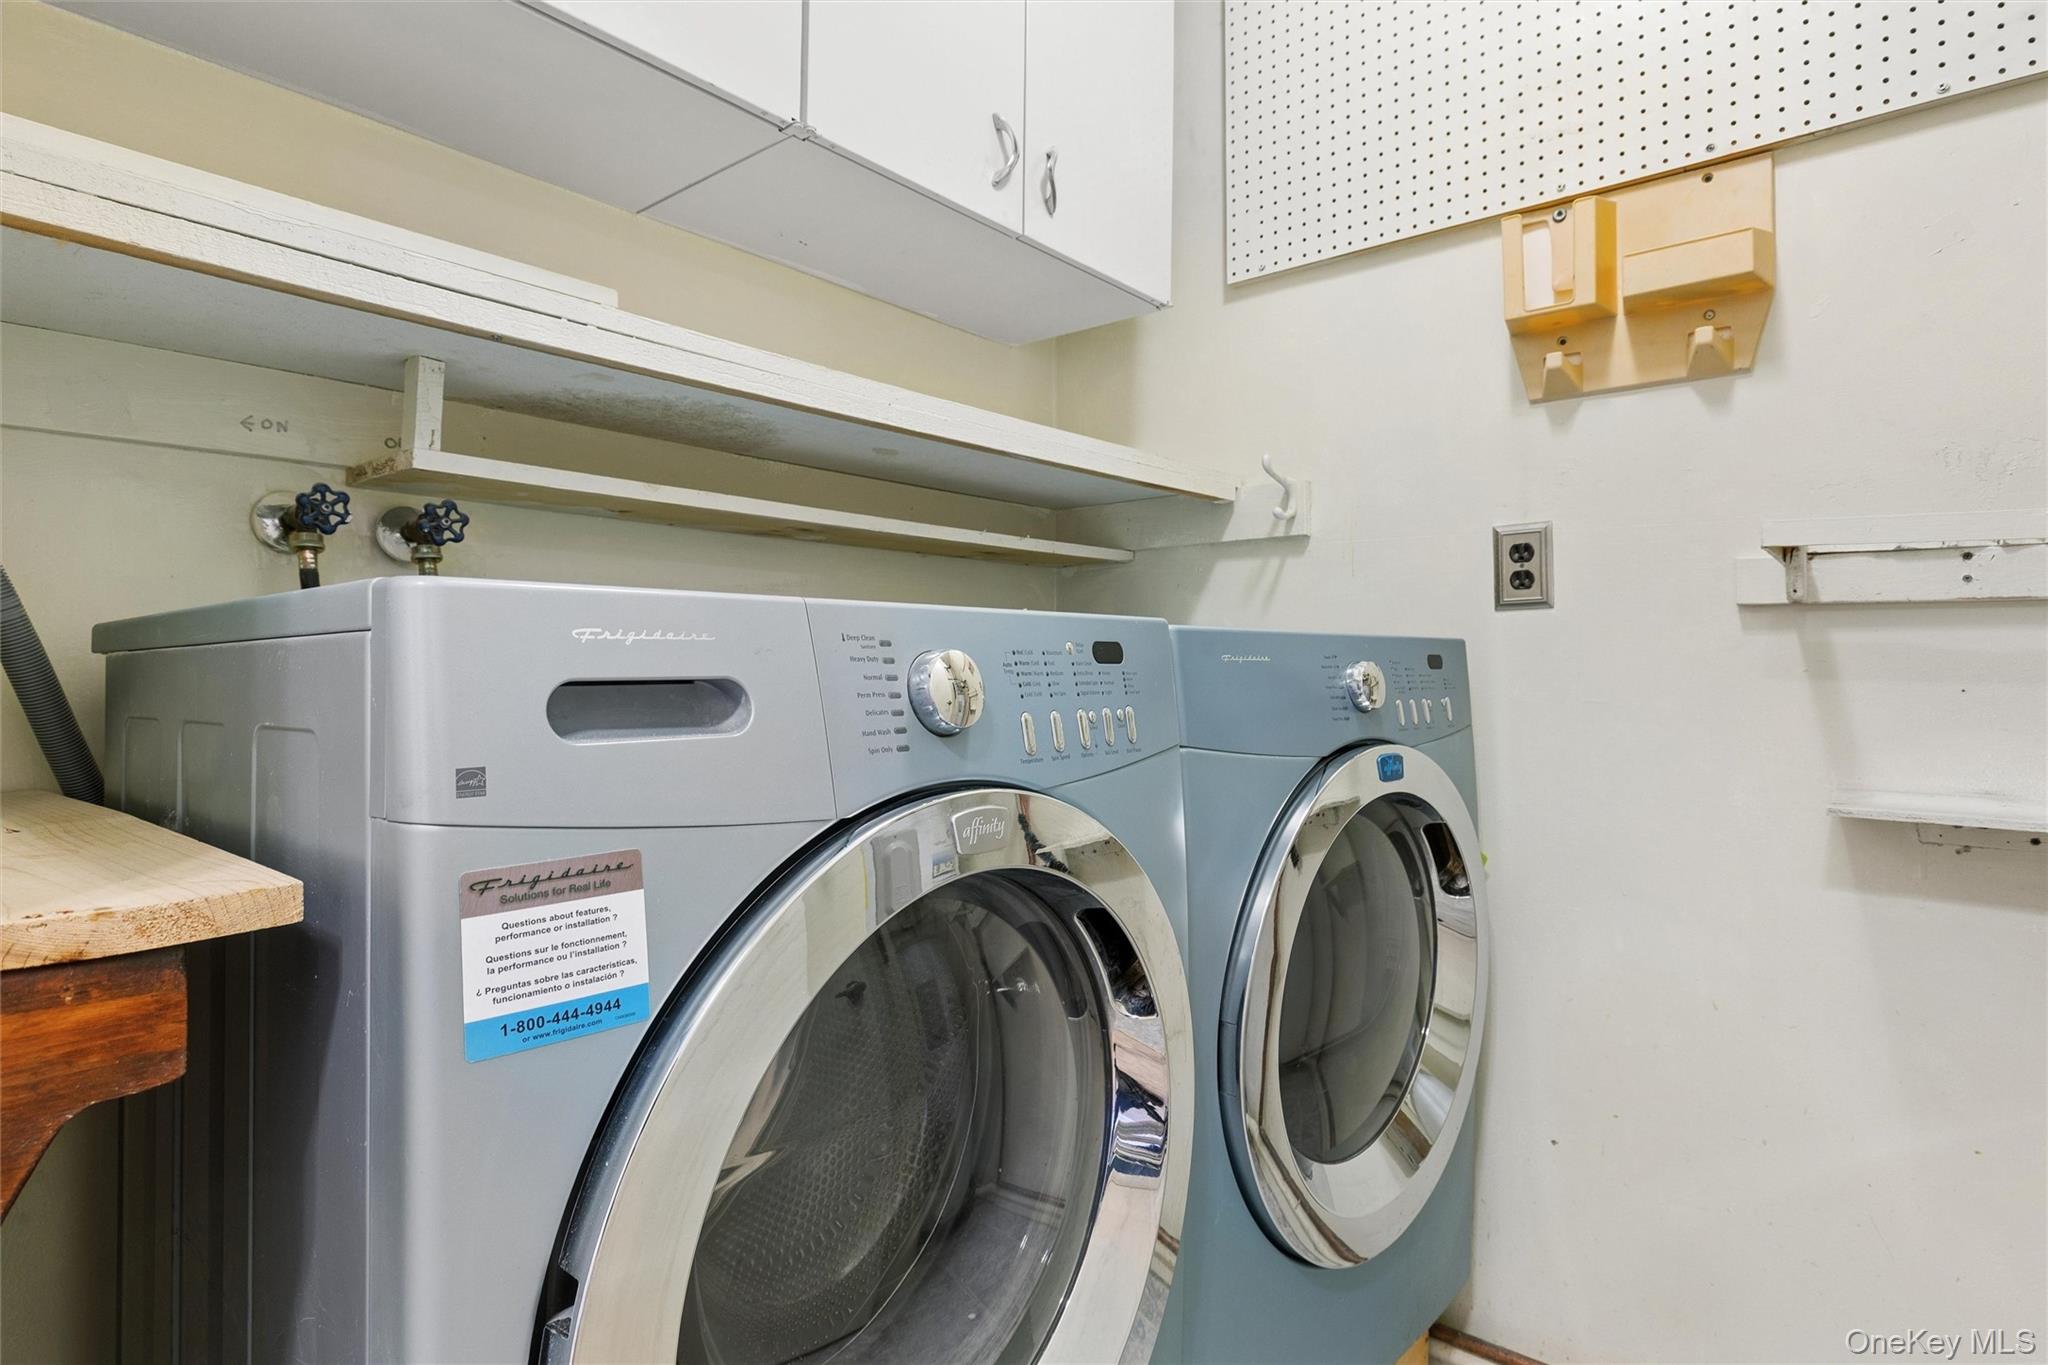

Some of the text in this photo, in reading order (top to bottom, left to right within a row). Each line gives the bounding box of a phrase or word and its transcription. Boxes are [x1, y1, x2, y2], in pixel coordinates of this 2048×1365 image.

[261, 418, 289, 433] ON
[572, 627, 716, 646] Frigidaire
[846, 634, 859, 642] Deep
[849, 655, 879, 663] Heavy Duty
[865, 709, 889, 717] Delicates
[862, 728, 891, 737] Hand Wash
[867, 747, 880, 756] Spin
[963, 816, 1005, 845] affinity
[469, 860, 634, 896] Frigidaire
[500, 879, 612, 905] Solutions for Real Life
[495, 927, 552, 944] performance
[565, 916, 611, 930] installation
[501, 905, 611, 931] Questions about features,
[485, 930, 628, 964] Questions sur le fonctionnement,
[486, 966, 495, 975] la
[497, 957, 555, 974] performance
[557, 954, 568, 962] ou
[570, 943, 620, 959] l'installation
[485, 979, 532, 996] Preguntas
[534, 974, 559, 985] sobre
[561, 970, 574, 980] las
[492, 984, 563, 1005] funcionamiento
[572, 972, 618, 988] instalación
[500, 998, 622, 1037] 1-800-444-4944
[532, 1018, 603, 1041] www.frigidaire.com
